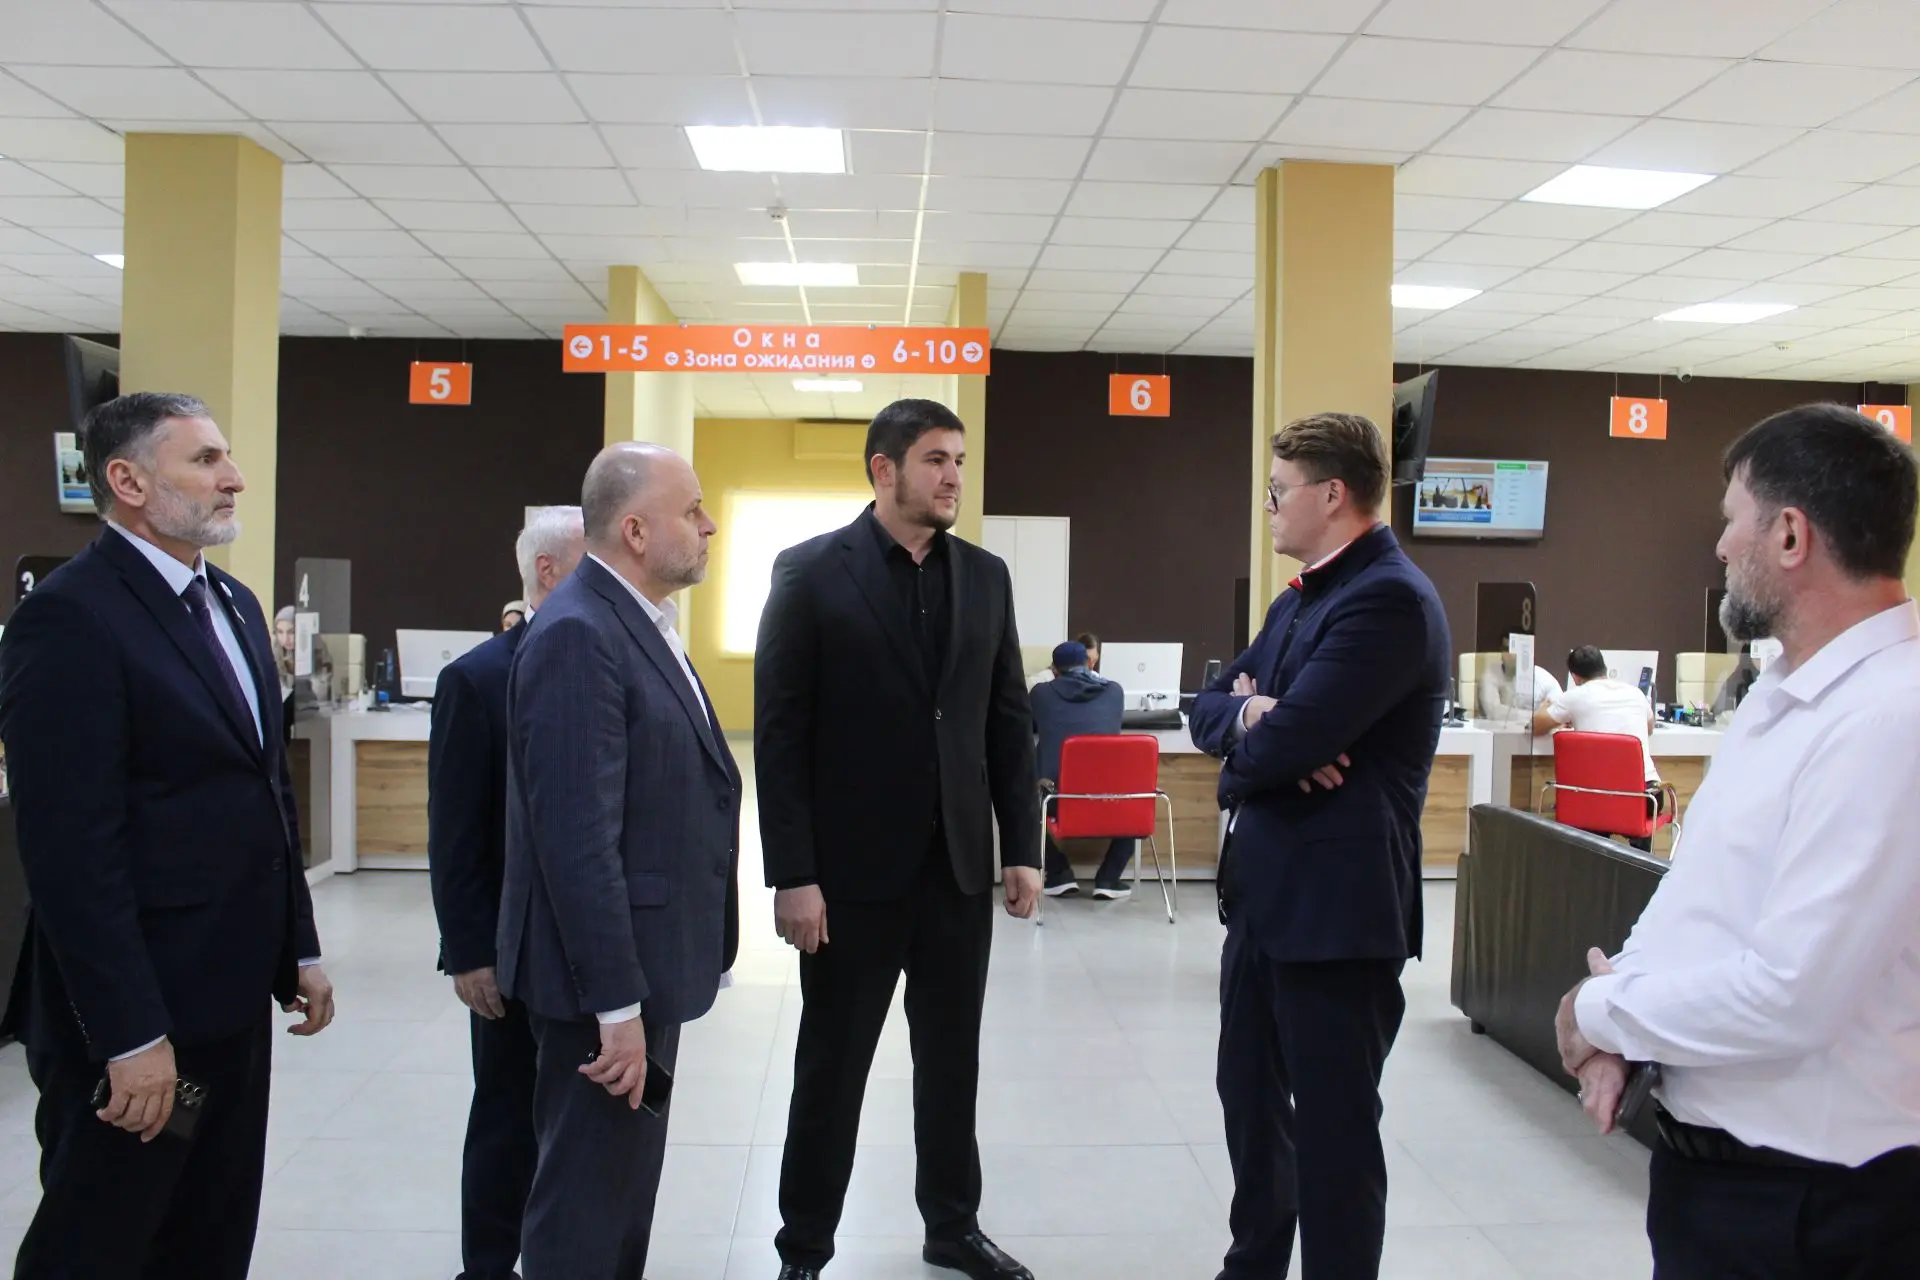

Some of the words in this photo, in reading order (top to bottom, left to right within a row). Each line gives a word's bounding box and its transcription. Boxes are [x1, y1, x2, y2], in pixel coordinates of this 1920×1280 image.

[600, 335, 648, 361] 1-5
[733, 327, 820, 348] Окна
[892, 339, 957, 364] 6-10
[684, 349, 737, 367] Зона
[744, 352, 855, 369] ожидания
[429, 367, 452, 400] 5
[1130, 379, 1152, 411] 6
[1628, 402, 1648, 434] 8
[1875, 409, 1896, 435] 9
[299, 572, 310, 608] 4
[1521, 597, 1532, 632] 8
